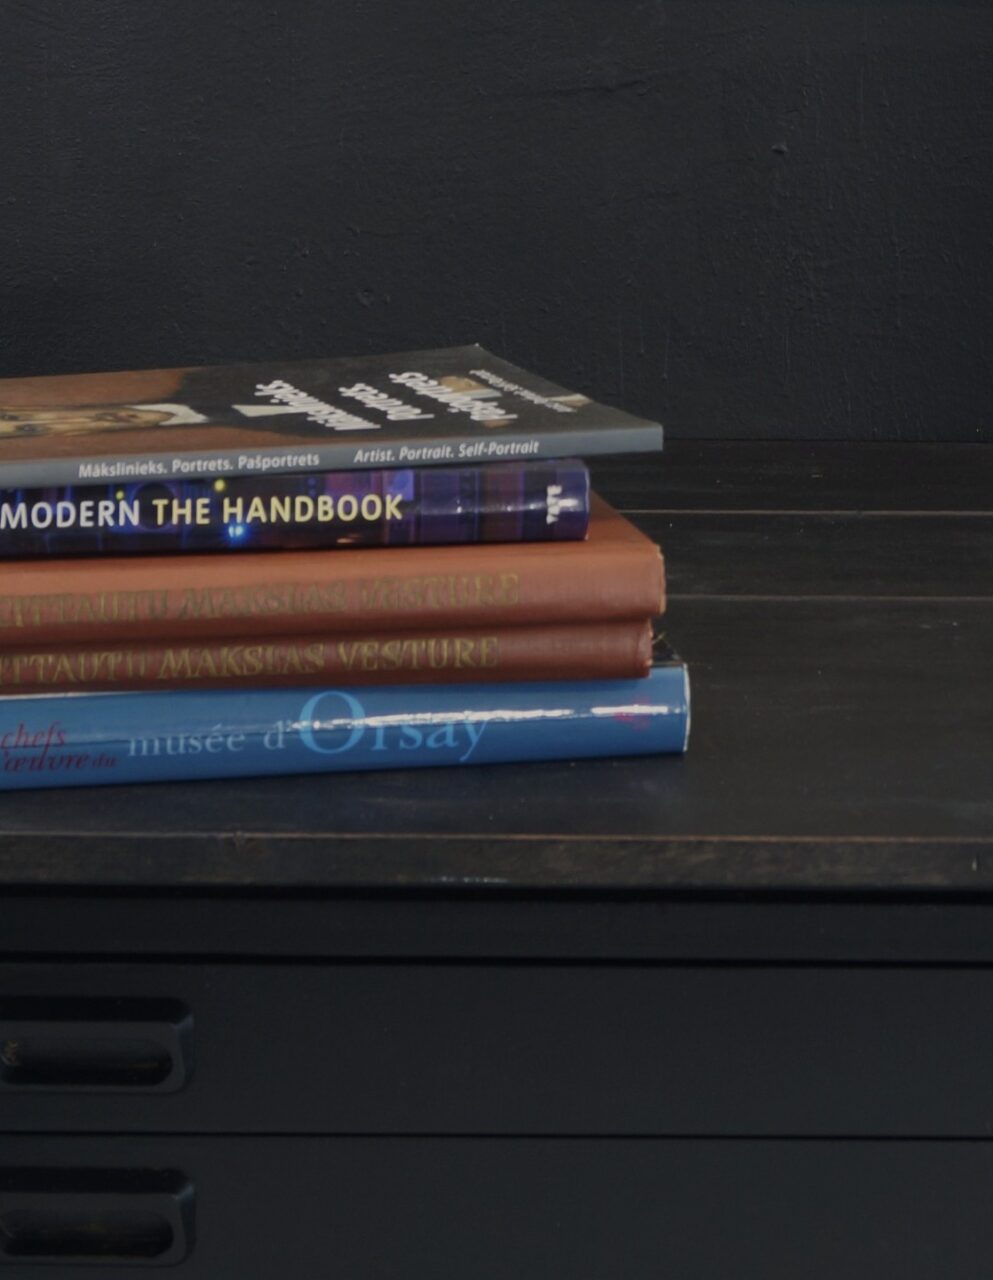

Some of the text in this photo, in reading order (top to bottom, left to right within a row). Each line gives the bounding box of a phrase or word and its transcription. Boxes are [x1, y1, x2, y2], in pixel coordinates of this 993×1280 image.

[172, 457, 233, 473] Portrets.
[238, 452, 320, 471] Pašportrets
[354, 440, 540, 463] Artist. Portrait. Self-Portrait
[0, 494, 403, 530] MODERN THE HANDBOOK
[127, 723, 246, 757] musée
